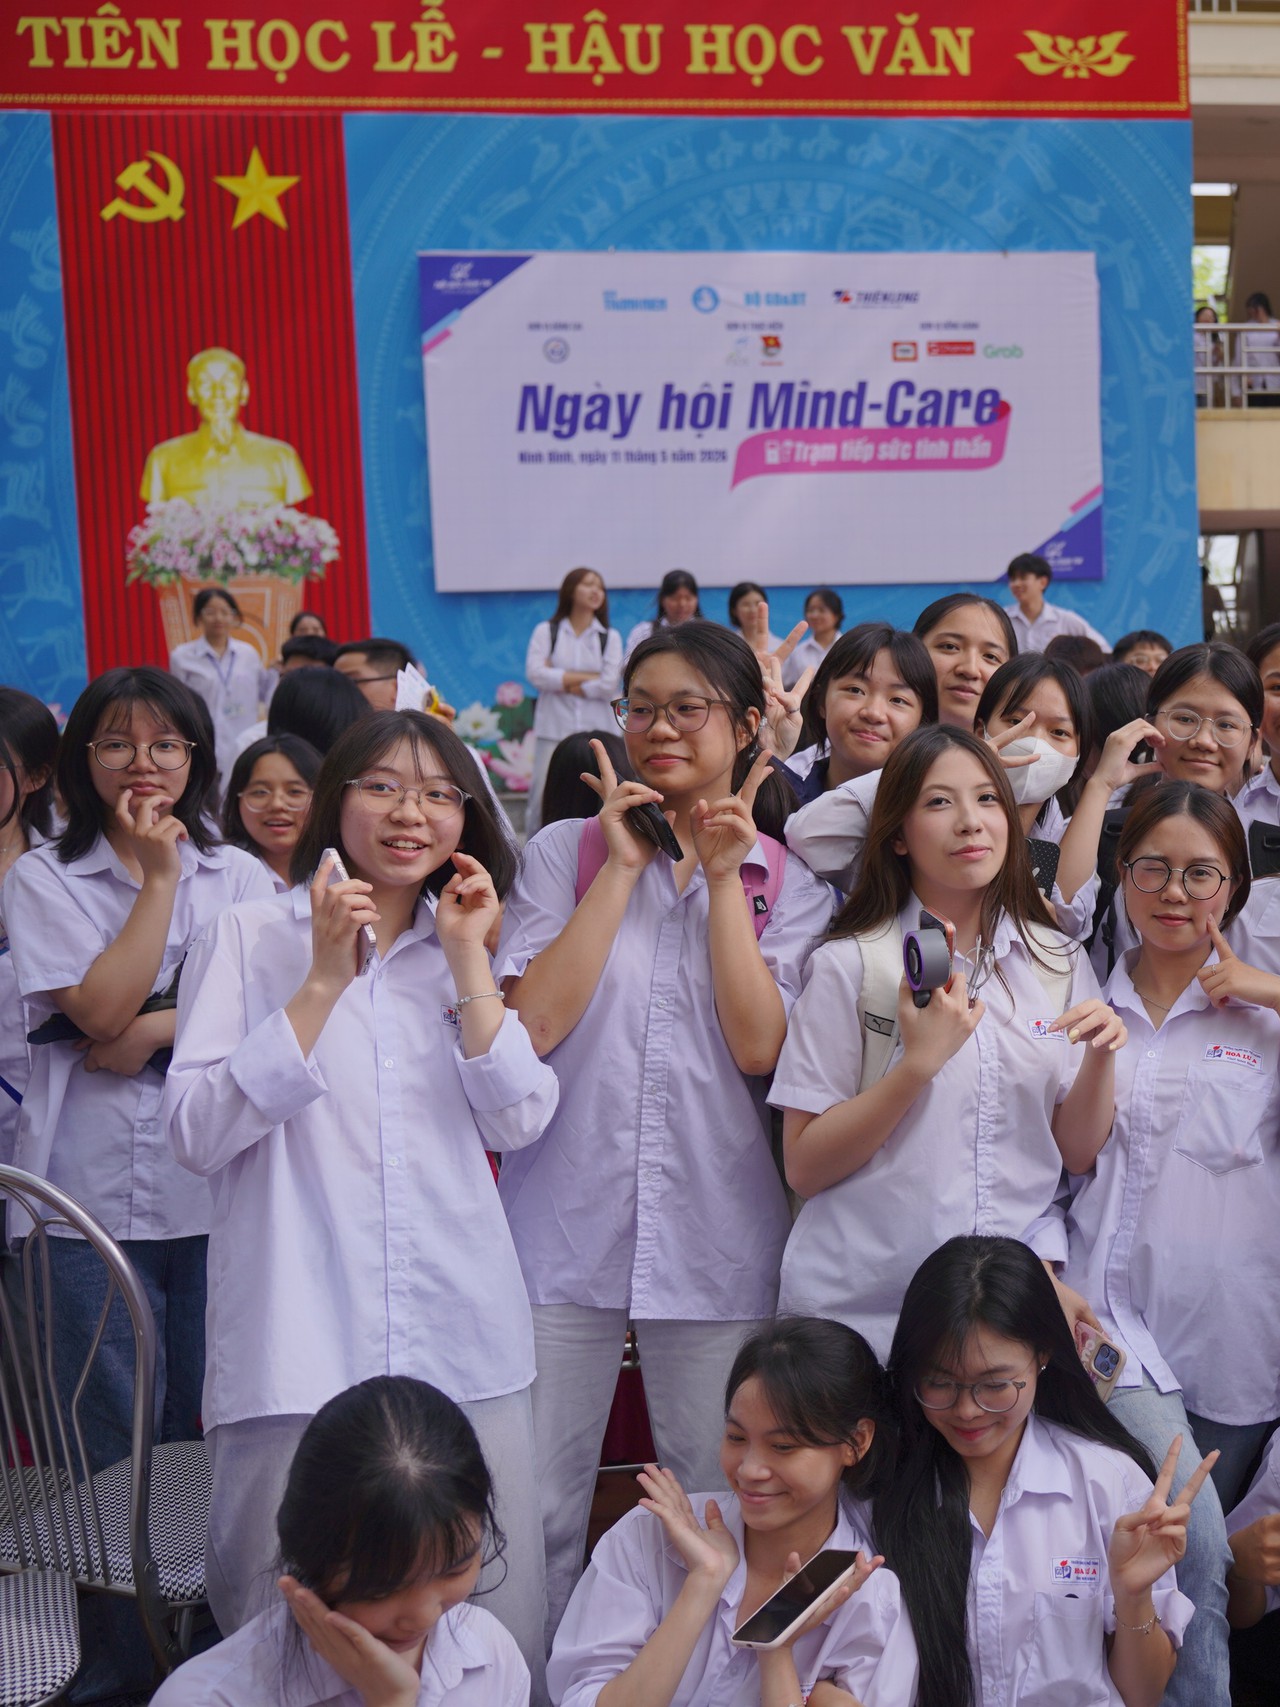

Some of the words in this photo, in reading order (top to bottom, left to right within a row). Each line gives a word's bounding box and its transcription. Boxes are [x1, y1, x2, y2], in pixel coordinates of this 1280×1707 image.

[17, 4, 182, 69] TIÊN
[205, 19, 351, 84] HỌC
[372, 0, 458, 73] LỄ
[525, 8, 664, 87] HẬU
[686, 23, 825, 88] HỌC
[842, 12, 974, 76] VĂN
[983, 344, 1024, 359] Grab
[517, 381, 642, 440] Ngày
[658, 382, 734, 439] hội
[748, 380, 1002, 430] Mind-Care
[518, 450, 545, 465] Ninh
[580, 451, 608, 467] ngày
[624, 449, 658, 466] tháng
[671, 450, 696, 463] năm
[794, 440, 838, 466] Trạm
[841, 436, 875, 464] tiếp
[877, 437, 912, 462] sức
[915, 438, 950, 461] tinh
[1225, 1050, 1241, 1058] HOA
